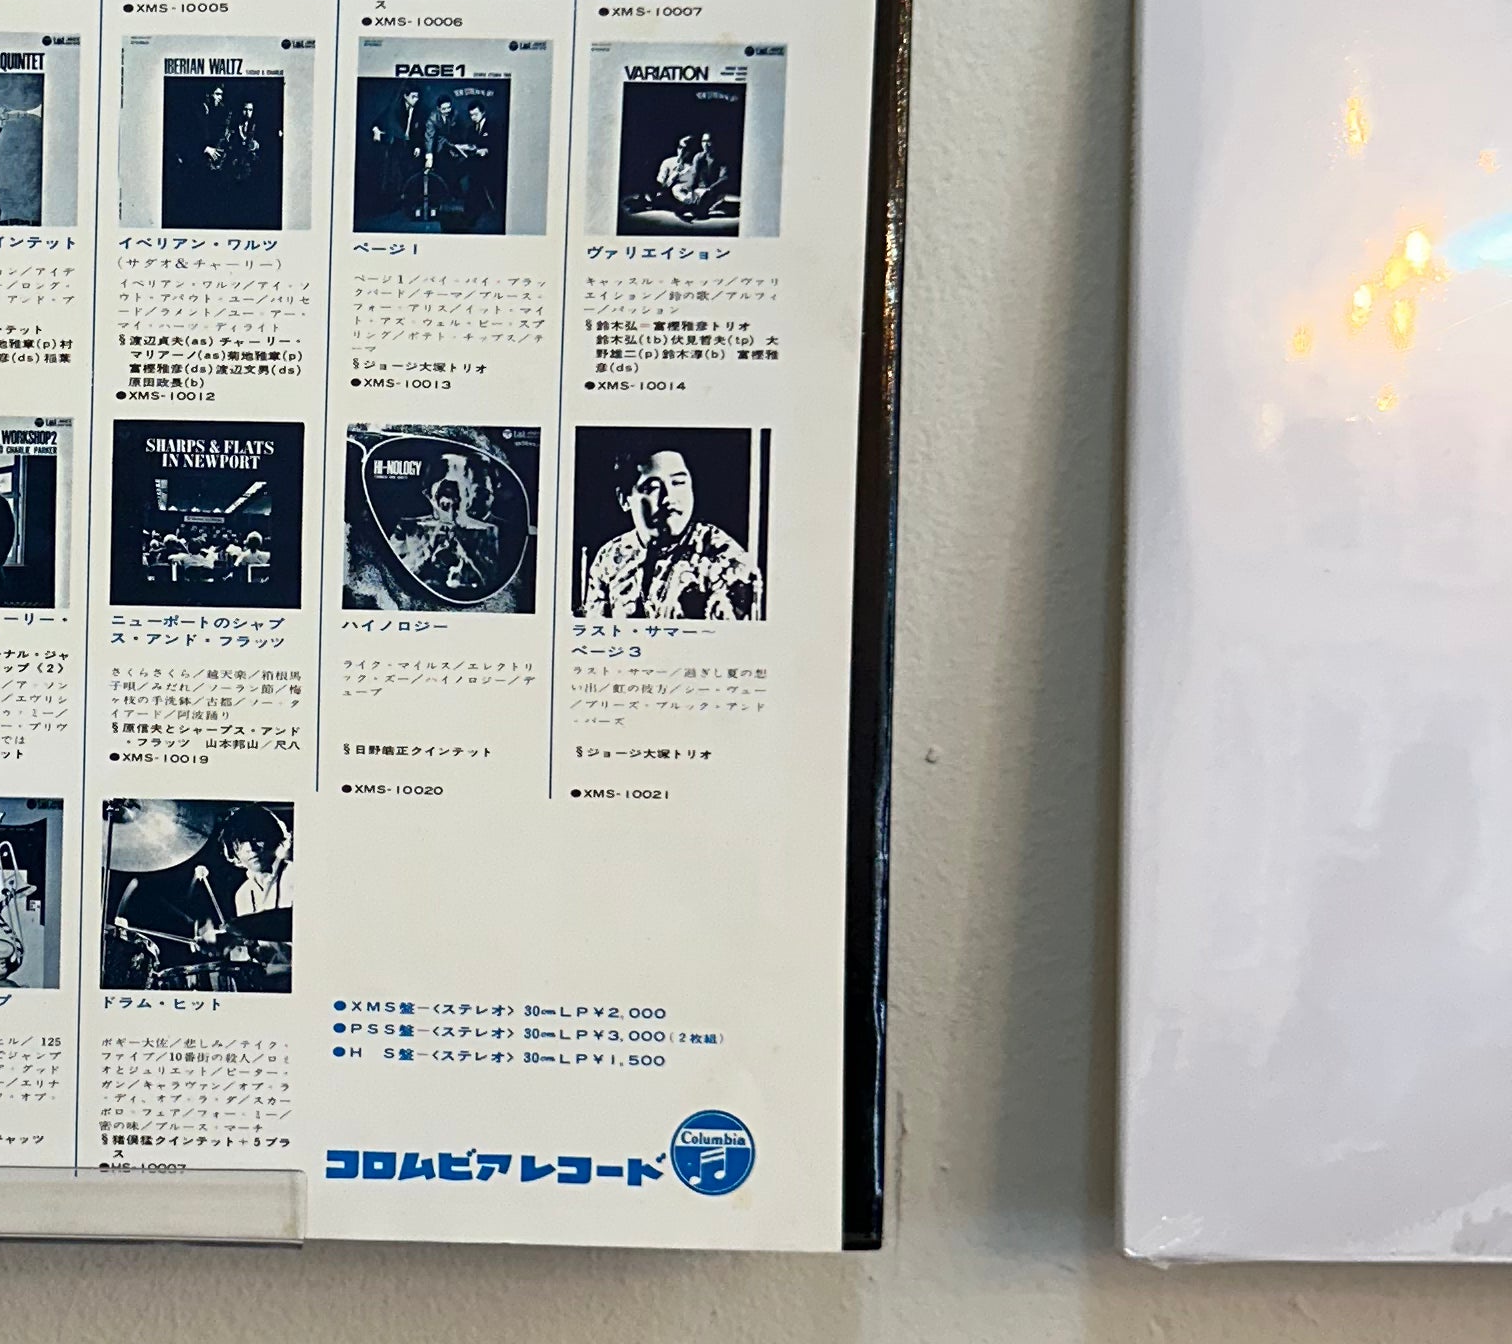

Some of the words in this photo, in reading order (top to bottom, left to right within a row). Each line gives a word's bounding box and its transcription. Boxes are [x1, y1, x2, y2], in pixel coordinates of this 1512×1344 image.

[135, 2, 230, 15] XMS-10005
[611, 6, 703, 18] XMS-10007
[374, 15, 464, 28] XMS-10006
[0, 52, 46, 71] QUINTET
[163, 57, 206, 75] IBERIAN
[208, 57, 244, 76] WALTZ
[624, 65, 710, 82] VARIATION
[363, 376, 453, 391] XMS-10013
[597, 379, 687, 392] XMS-10014
[128, 389, 216, 403] XMS-10012
[0, 429, 58, 446] WORKSHOP2
[145, 437, 207, 454] SHARPS
[208, 439, 222, 455] &
[223, 439, 275, 456] FLATS
[161, 453, 181, 468] IN
[182, 453, 261, 470] NEWPORT
[372, 459, 423, 477] HI-NOLOGY
[121, 751, 210, 765] XMS-10019
[354, 782, 444, 797] XMS-10020
[583, 787, 671, 800] XMS-10021
[679, 1130, 747, 1147] Columbia
